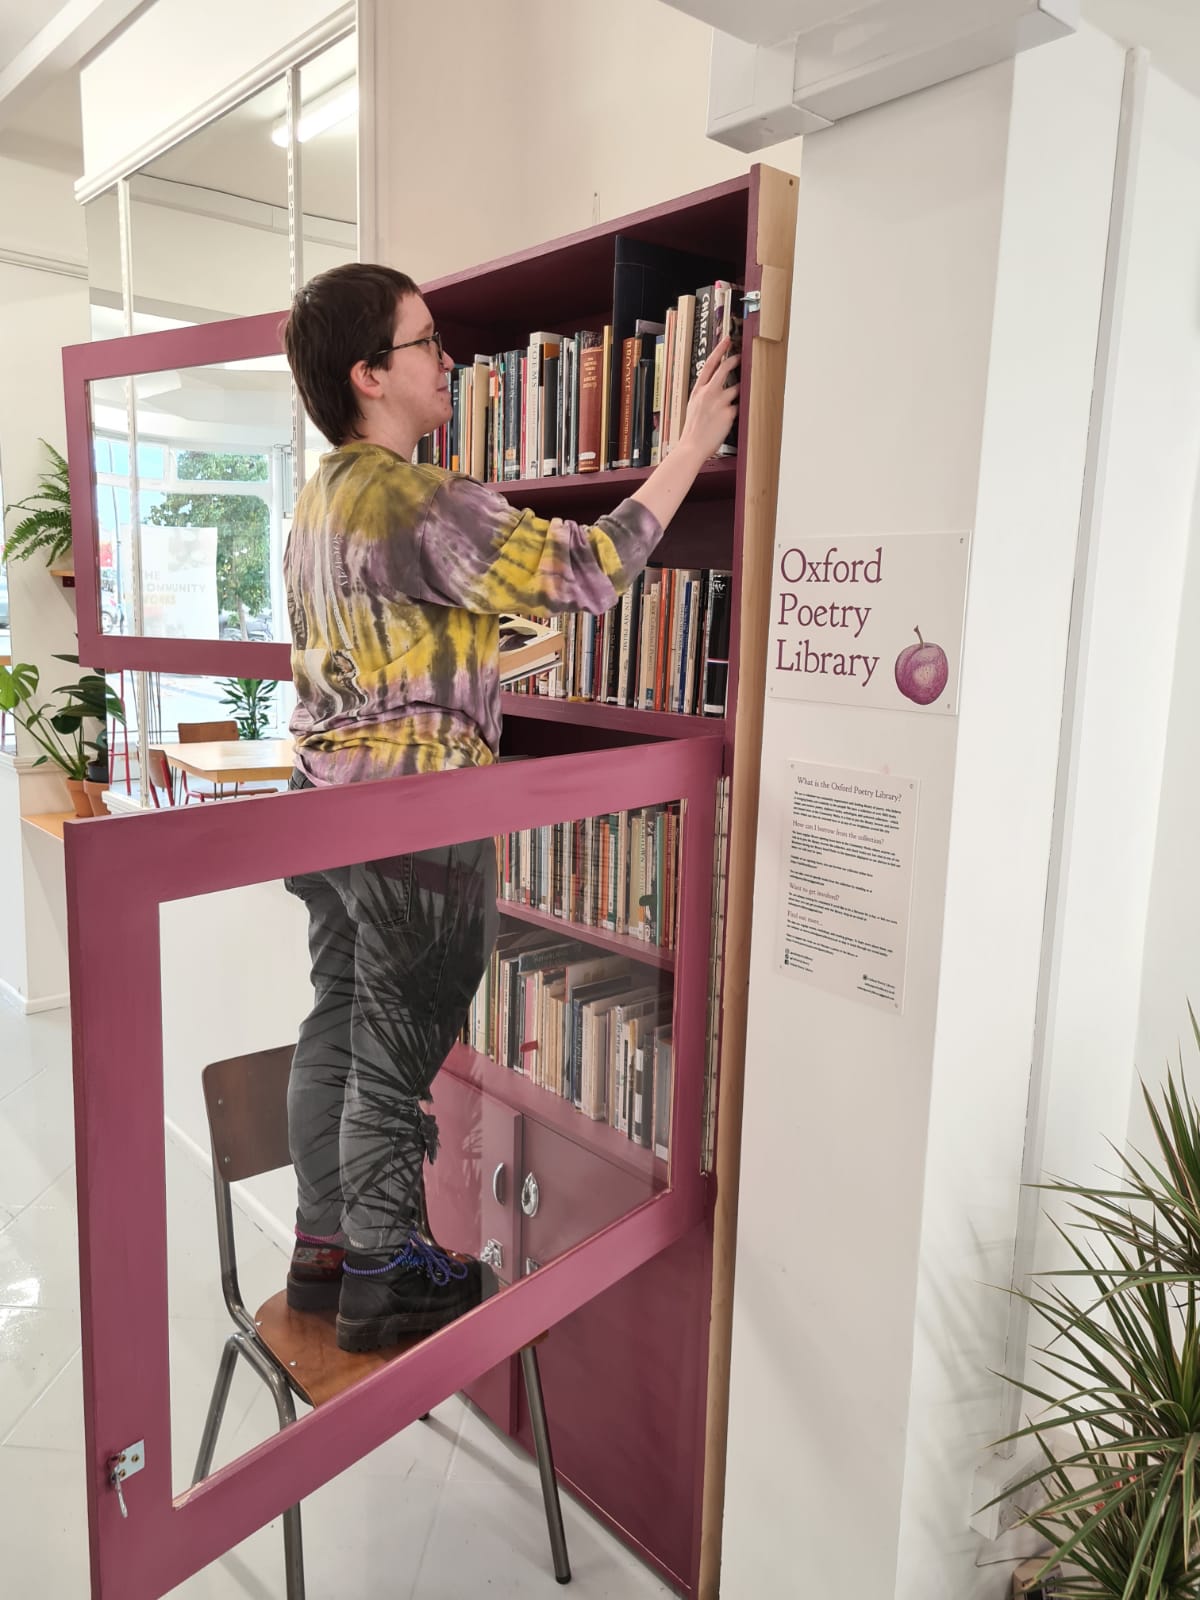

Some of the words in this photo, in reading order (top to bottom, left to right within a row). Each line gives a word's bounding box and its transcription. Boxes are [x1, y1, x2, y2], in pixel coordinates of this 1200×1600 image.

[698, 293, 710, 356] CHARLES
[780, 546, 883, 583] Oxford
[777, 593, 872, 638] Poetry
[775, 639, 881, 687] Library
[797, 776, 814, 787] What
[814, 779, 819, 787] is
[820, 779, 830, 789] the
[831, 782, 853, 793] Oxford
[853, 787, 874, 798] Poetry
[875, 790, 902, 802] Library?
[792, 820, 805, 828] How
[848, 830, 857, 839] the
